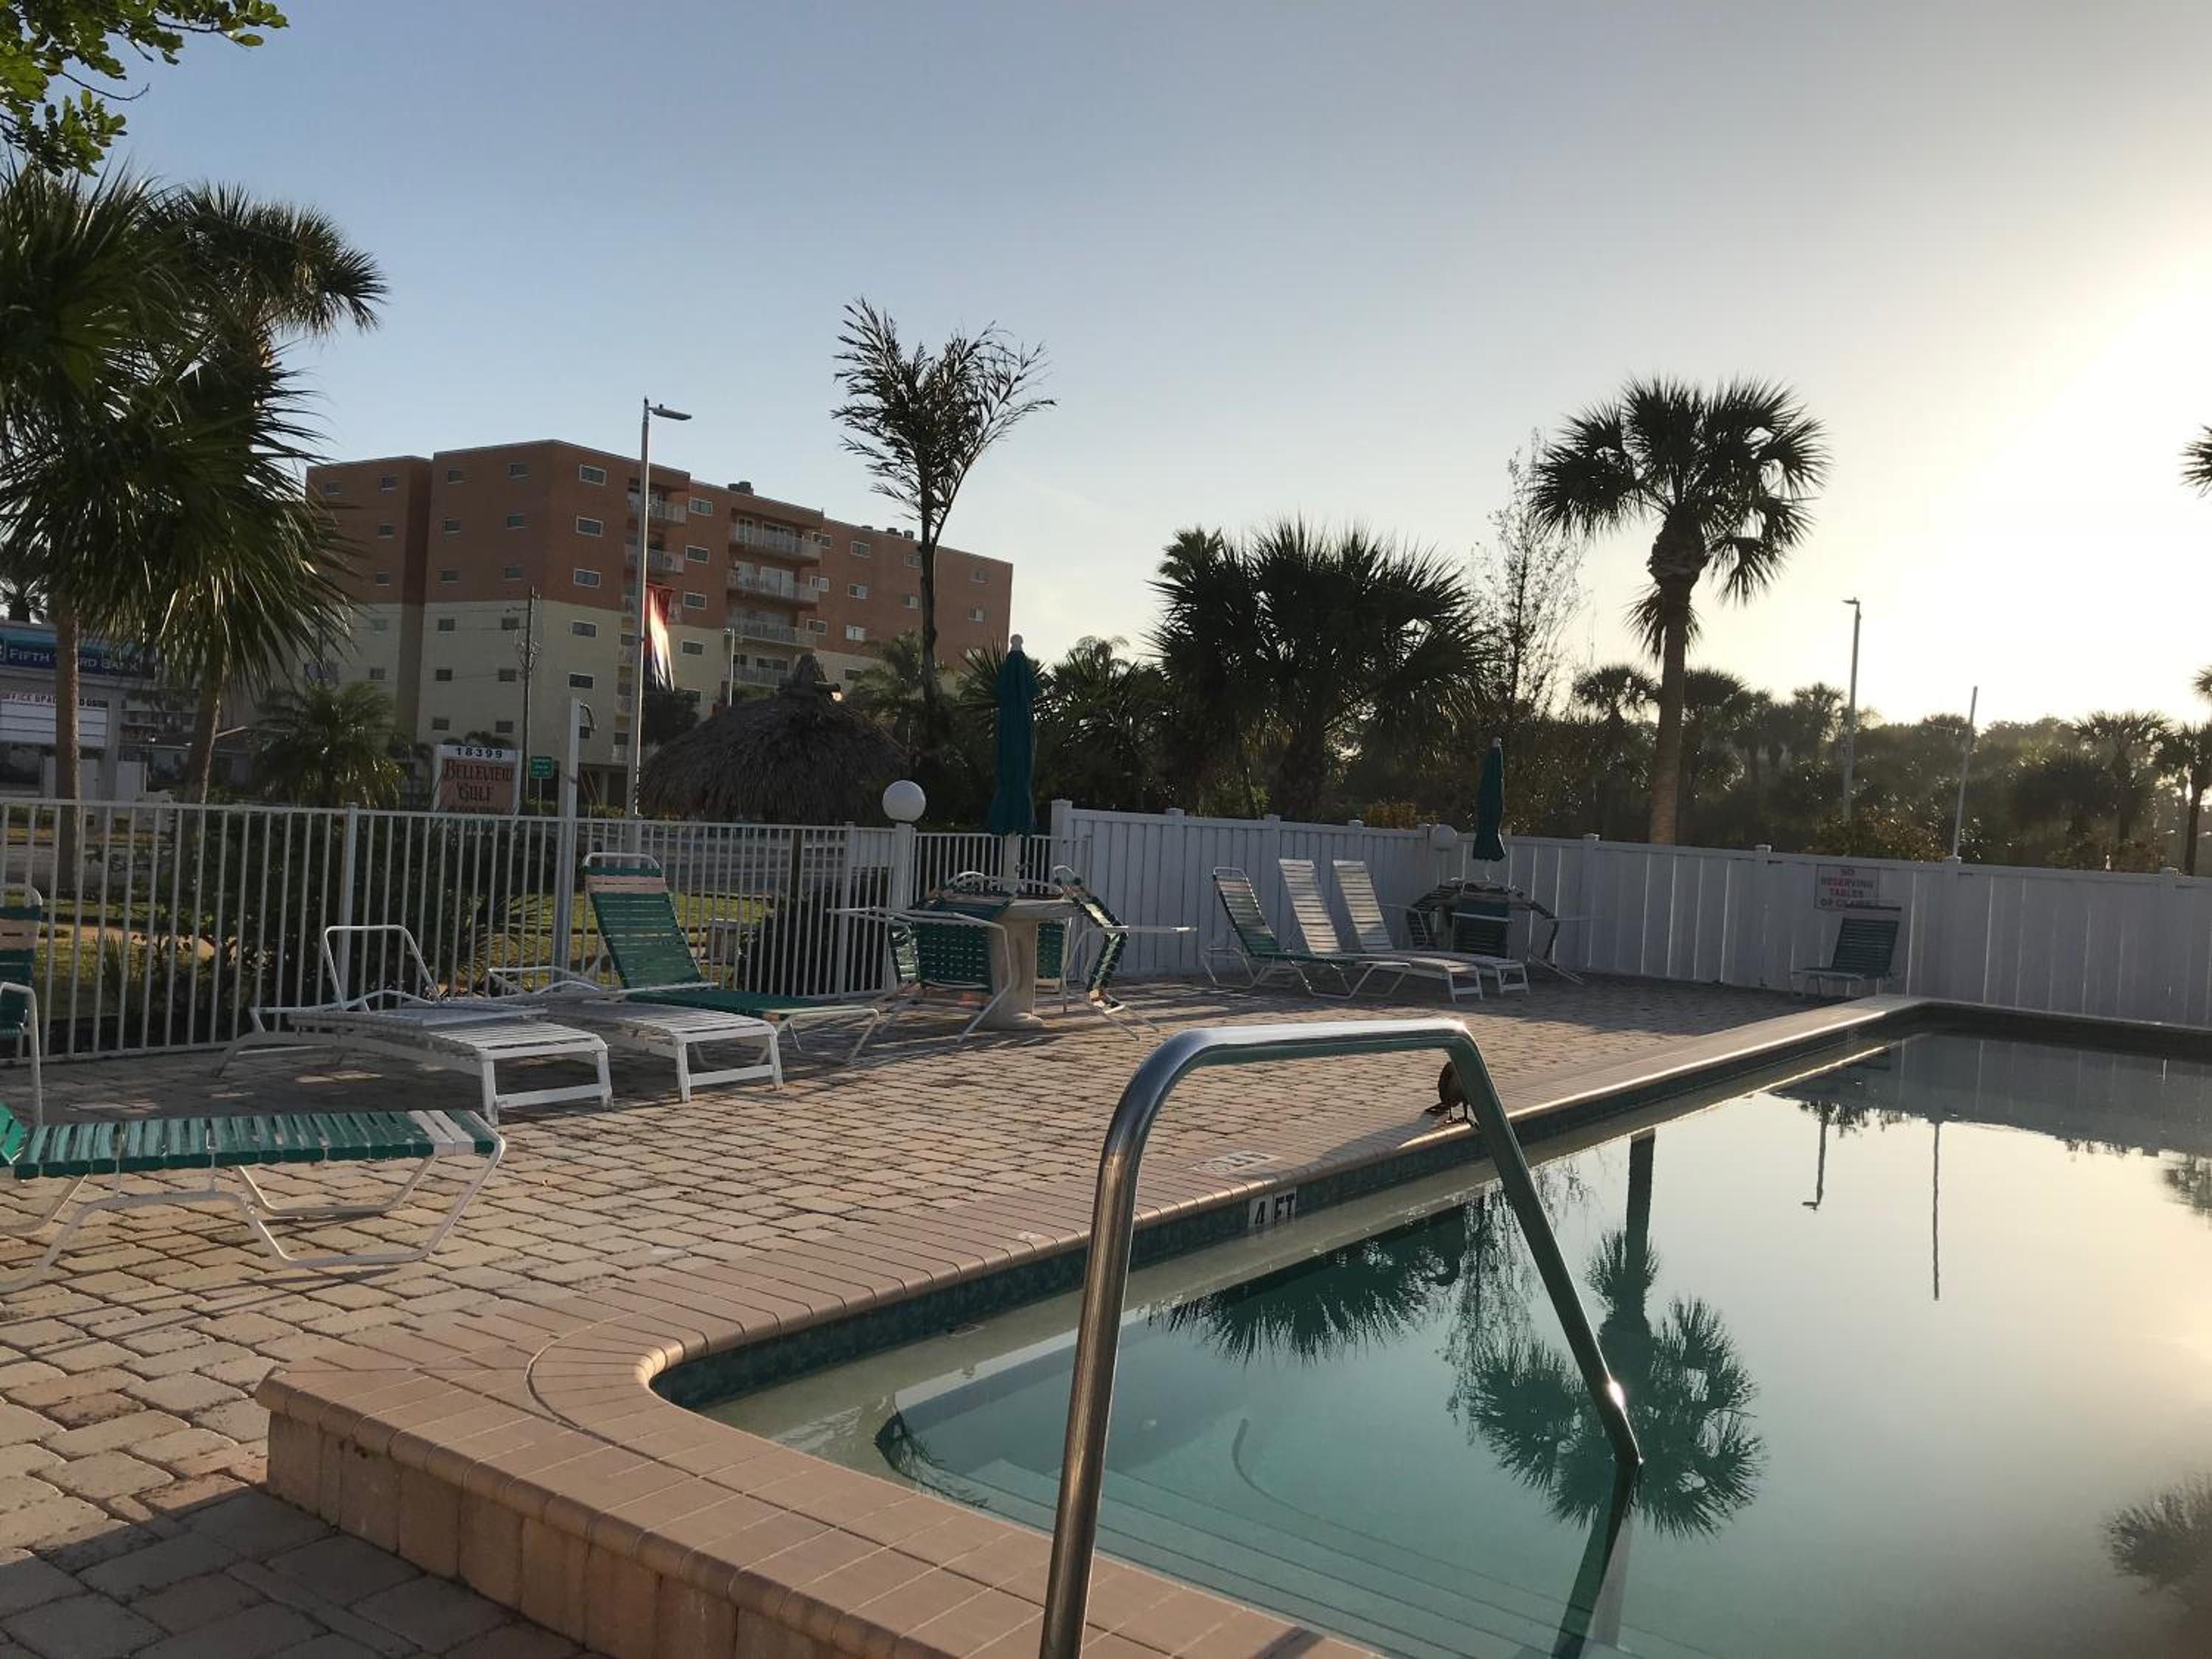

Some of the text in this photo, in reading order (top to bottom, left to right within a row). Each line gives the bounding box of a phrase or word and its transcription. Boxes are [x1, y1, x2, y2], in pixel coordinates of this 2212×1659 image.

[9, 648, 50, 662] FIFTH
[35, 695, 58, 704] SPAC
[456, 747, 503, 759] 18399
[1829, 888, 1865, 898] TABLES
[1254, 1193, 1295, 1224] 4 FT
